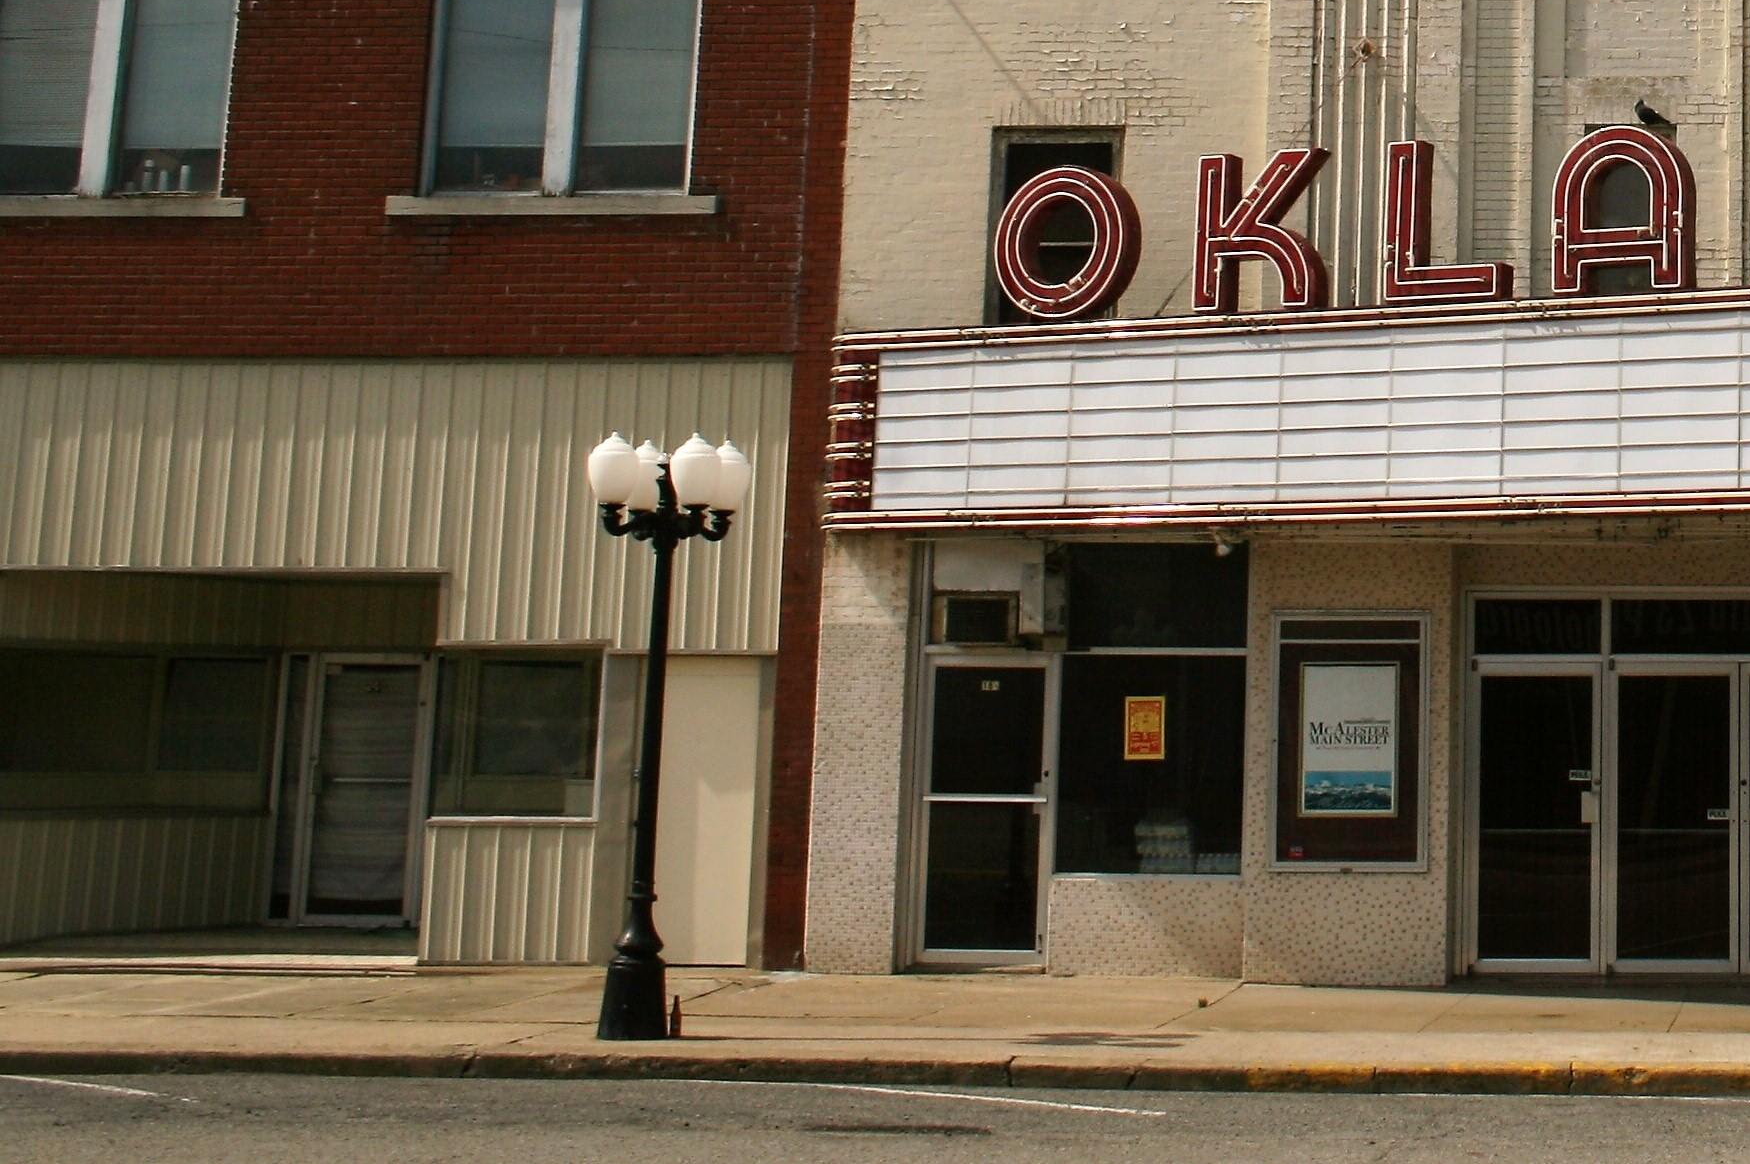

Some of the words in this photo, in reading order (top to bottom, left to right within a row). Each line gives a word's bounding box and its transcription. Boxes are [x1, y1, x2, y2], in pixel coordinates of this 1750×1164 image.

[995, 125, 1697, 319] OKLA
[1309, 734, 1342, 745] MAIN
[1344, 734, 1389, 745] STREET
